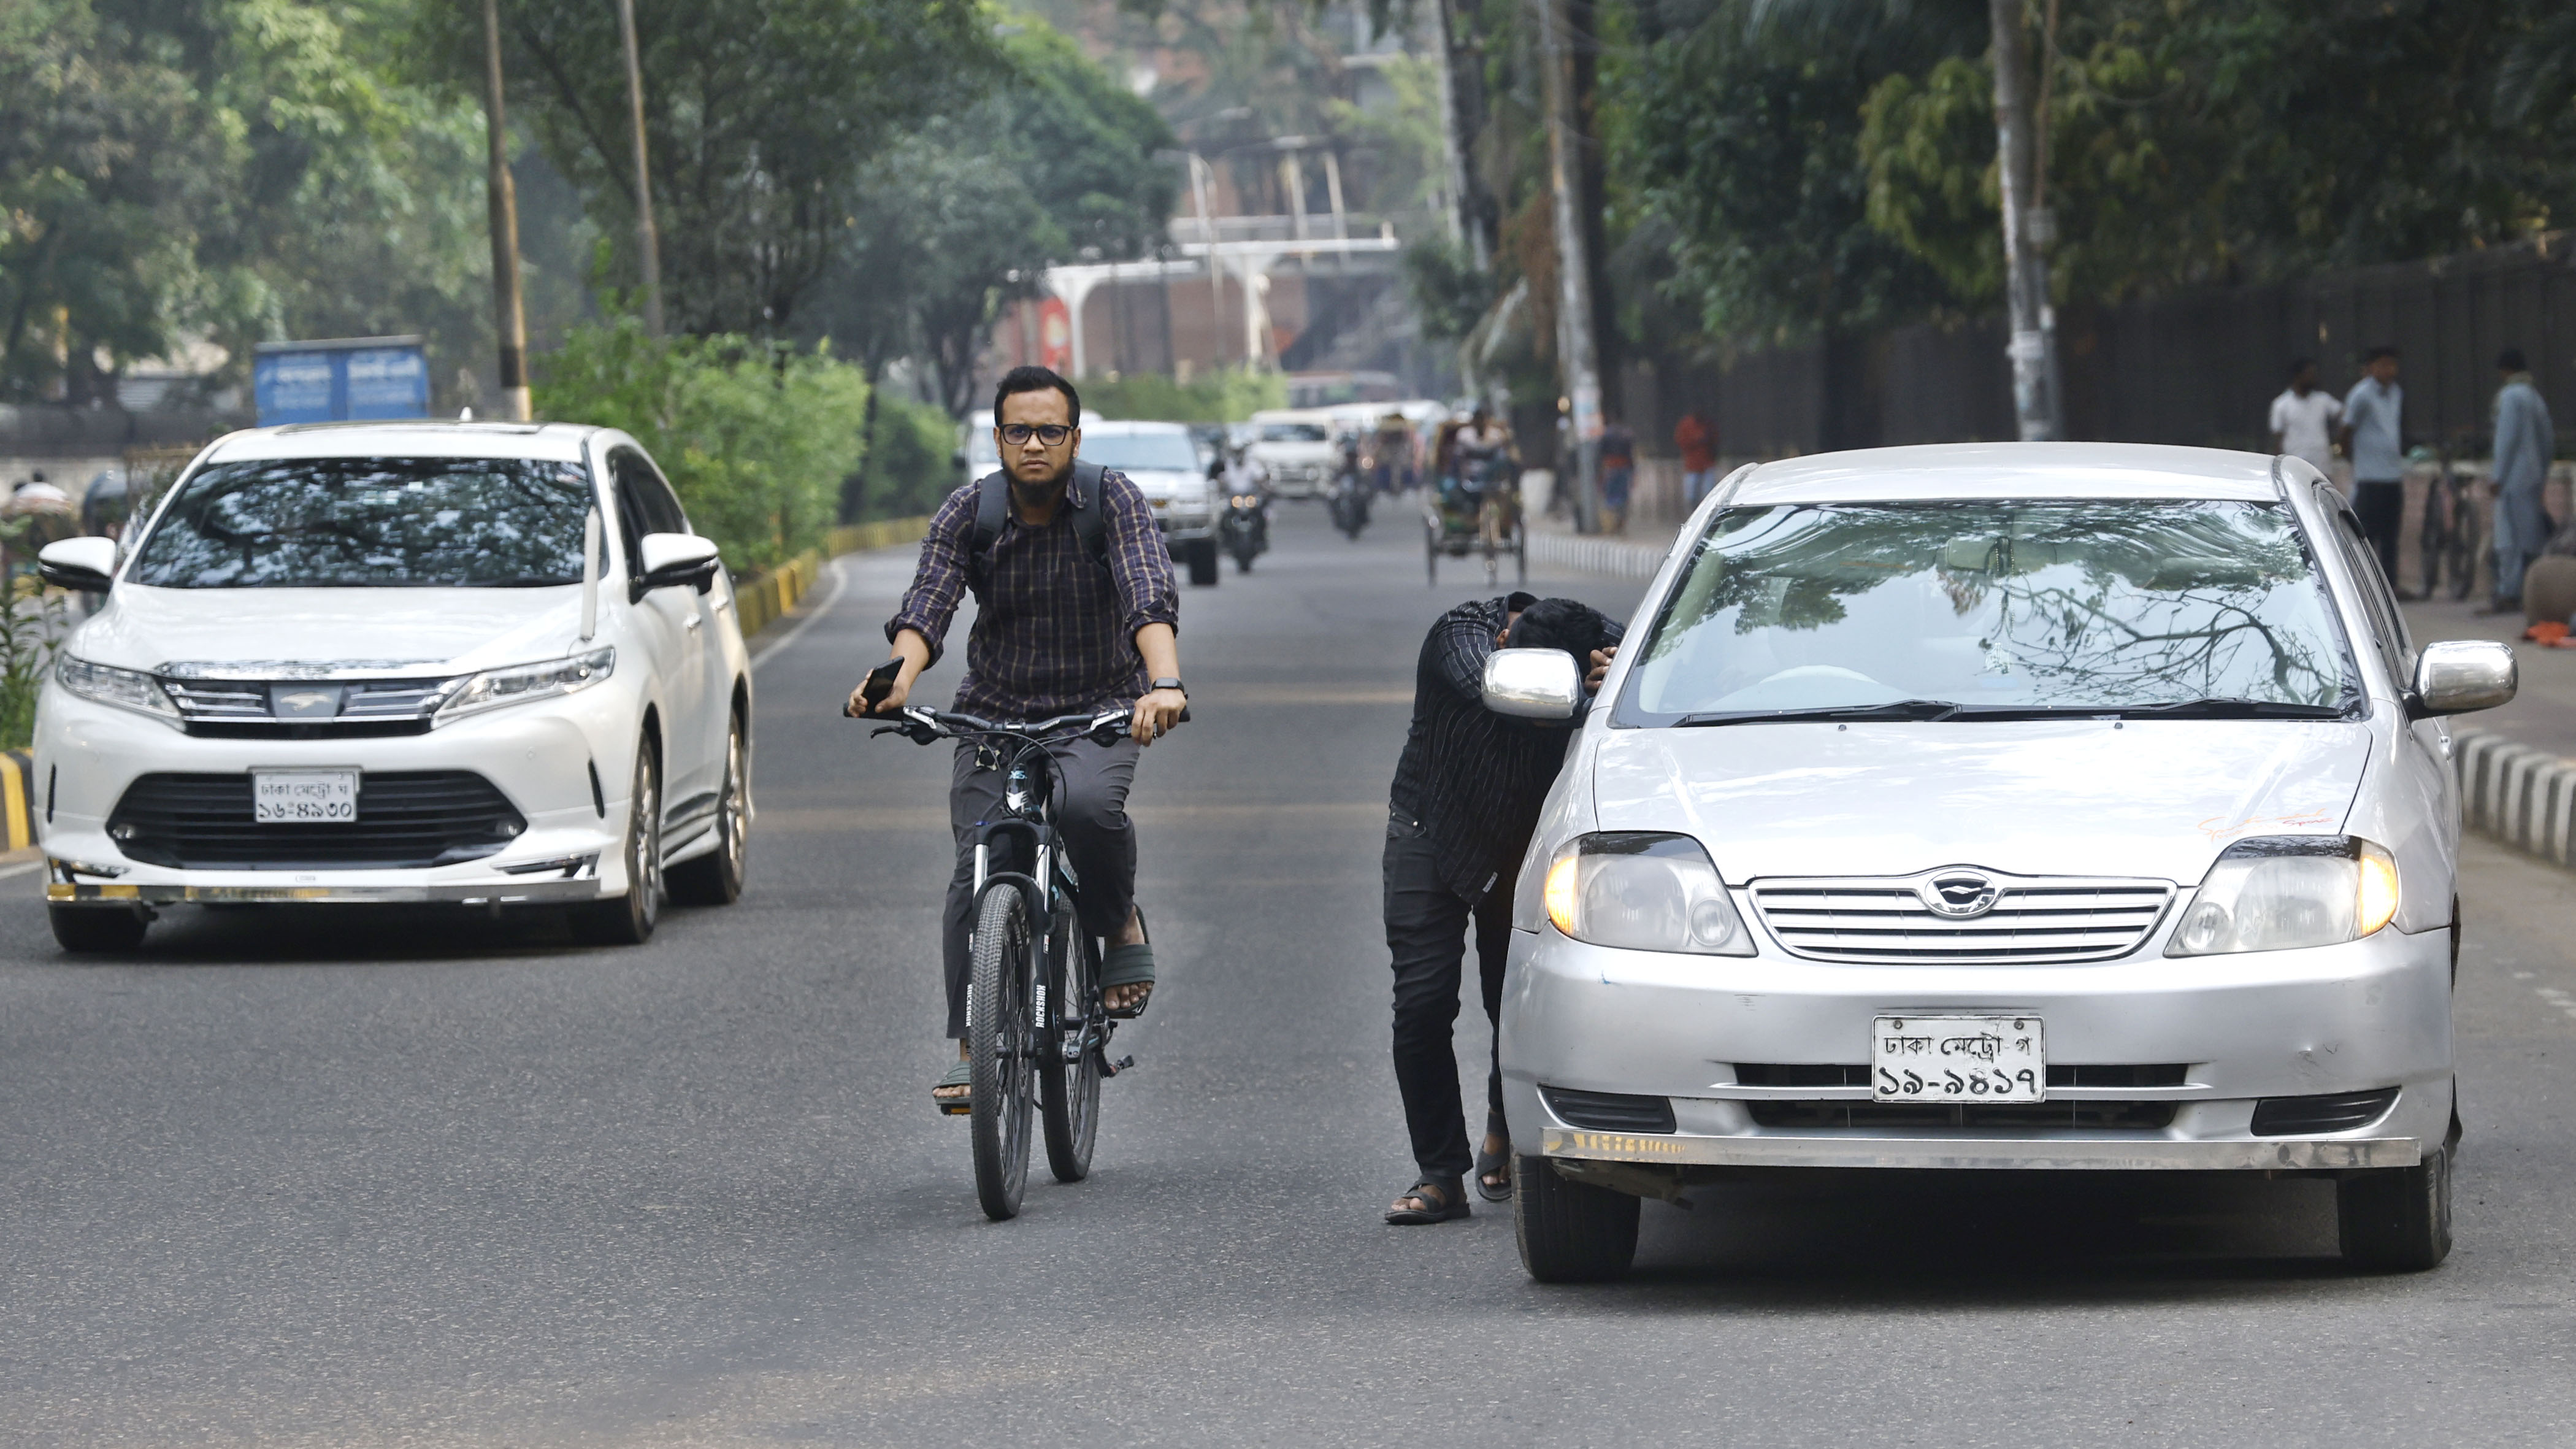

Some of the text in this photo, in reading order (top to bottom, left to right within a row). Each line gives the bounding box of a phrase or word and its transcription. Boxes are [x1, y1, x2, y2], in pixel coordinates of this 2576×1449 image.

[1035, 984, 1046, 1028] ROCKSHOX
[1884, 1036, 1934, 1055] ঢাকা
[1940, 1031, 2003, 1064] মেট্রো
